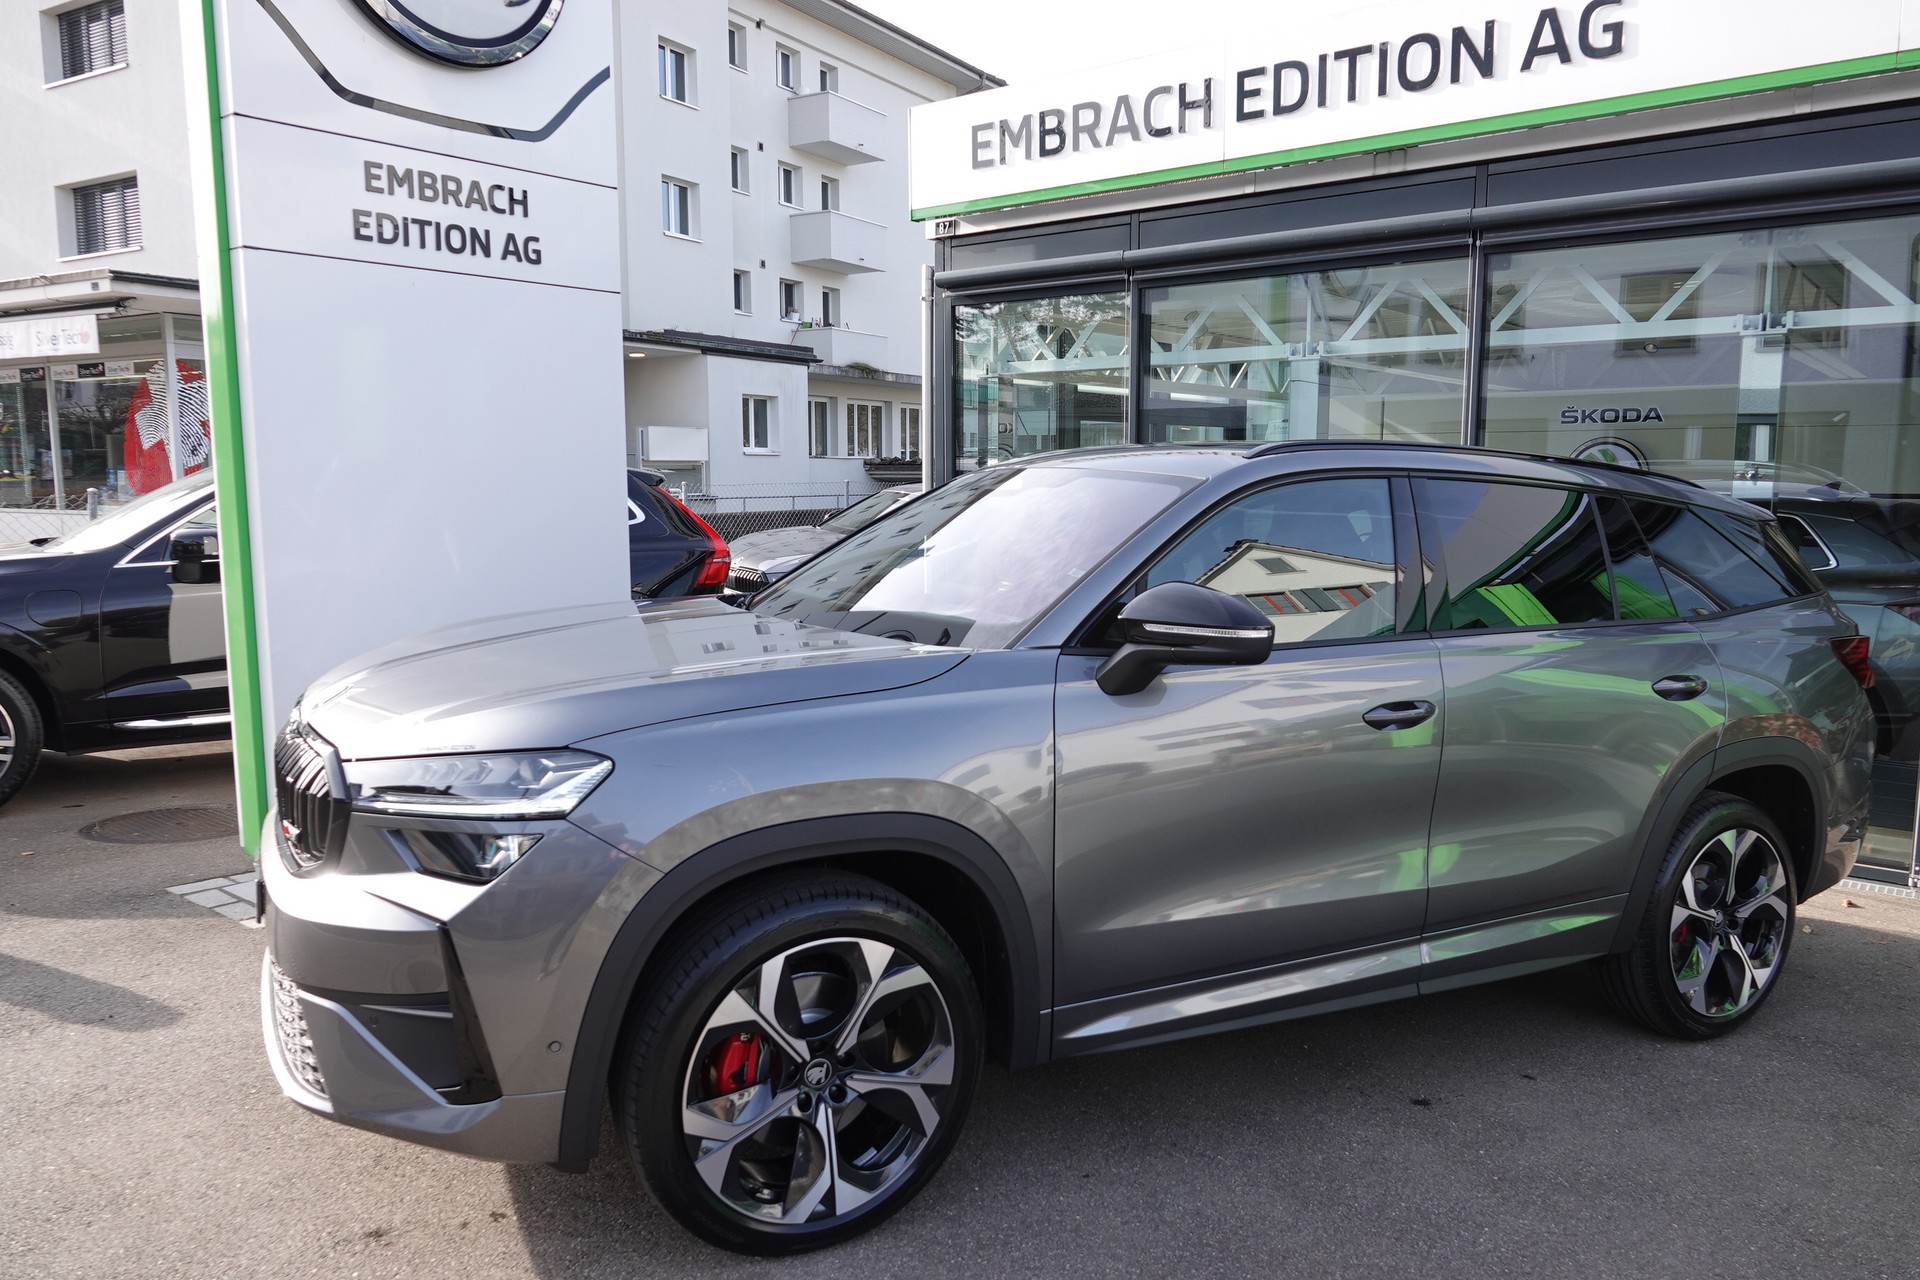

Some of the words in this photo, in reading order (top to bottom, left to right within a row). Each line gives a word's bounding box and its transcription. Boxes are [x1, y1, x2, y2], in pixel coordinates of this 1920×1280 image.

[972, 77, 1213, 169] EMBRACH
[1236, 19, 1498, 122] EDITION
[1520, 0, 1625, 73] AG
[363, 160, 529, 218] EMBRACH
[352, 208, 492, 258] EDITION
[501, 232, 542, 265] AG
[939, 221, 950, 235] 87
[1560, 405, 1663, 424] ŠKODA
